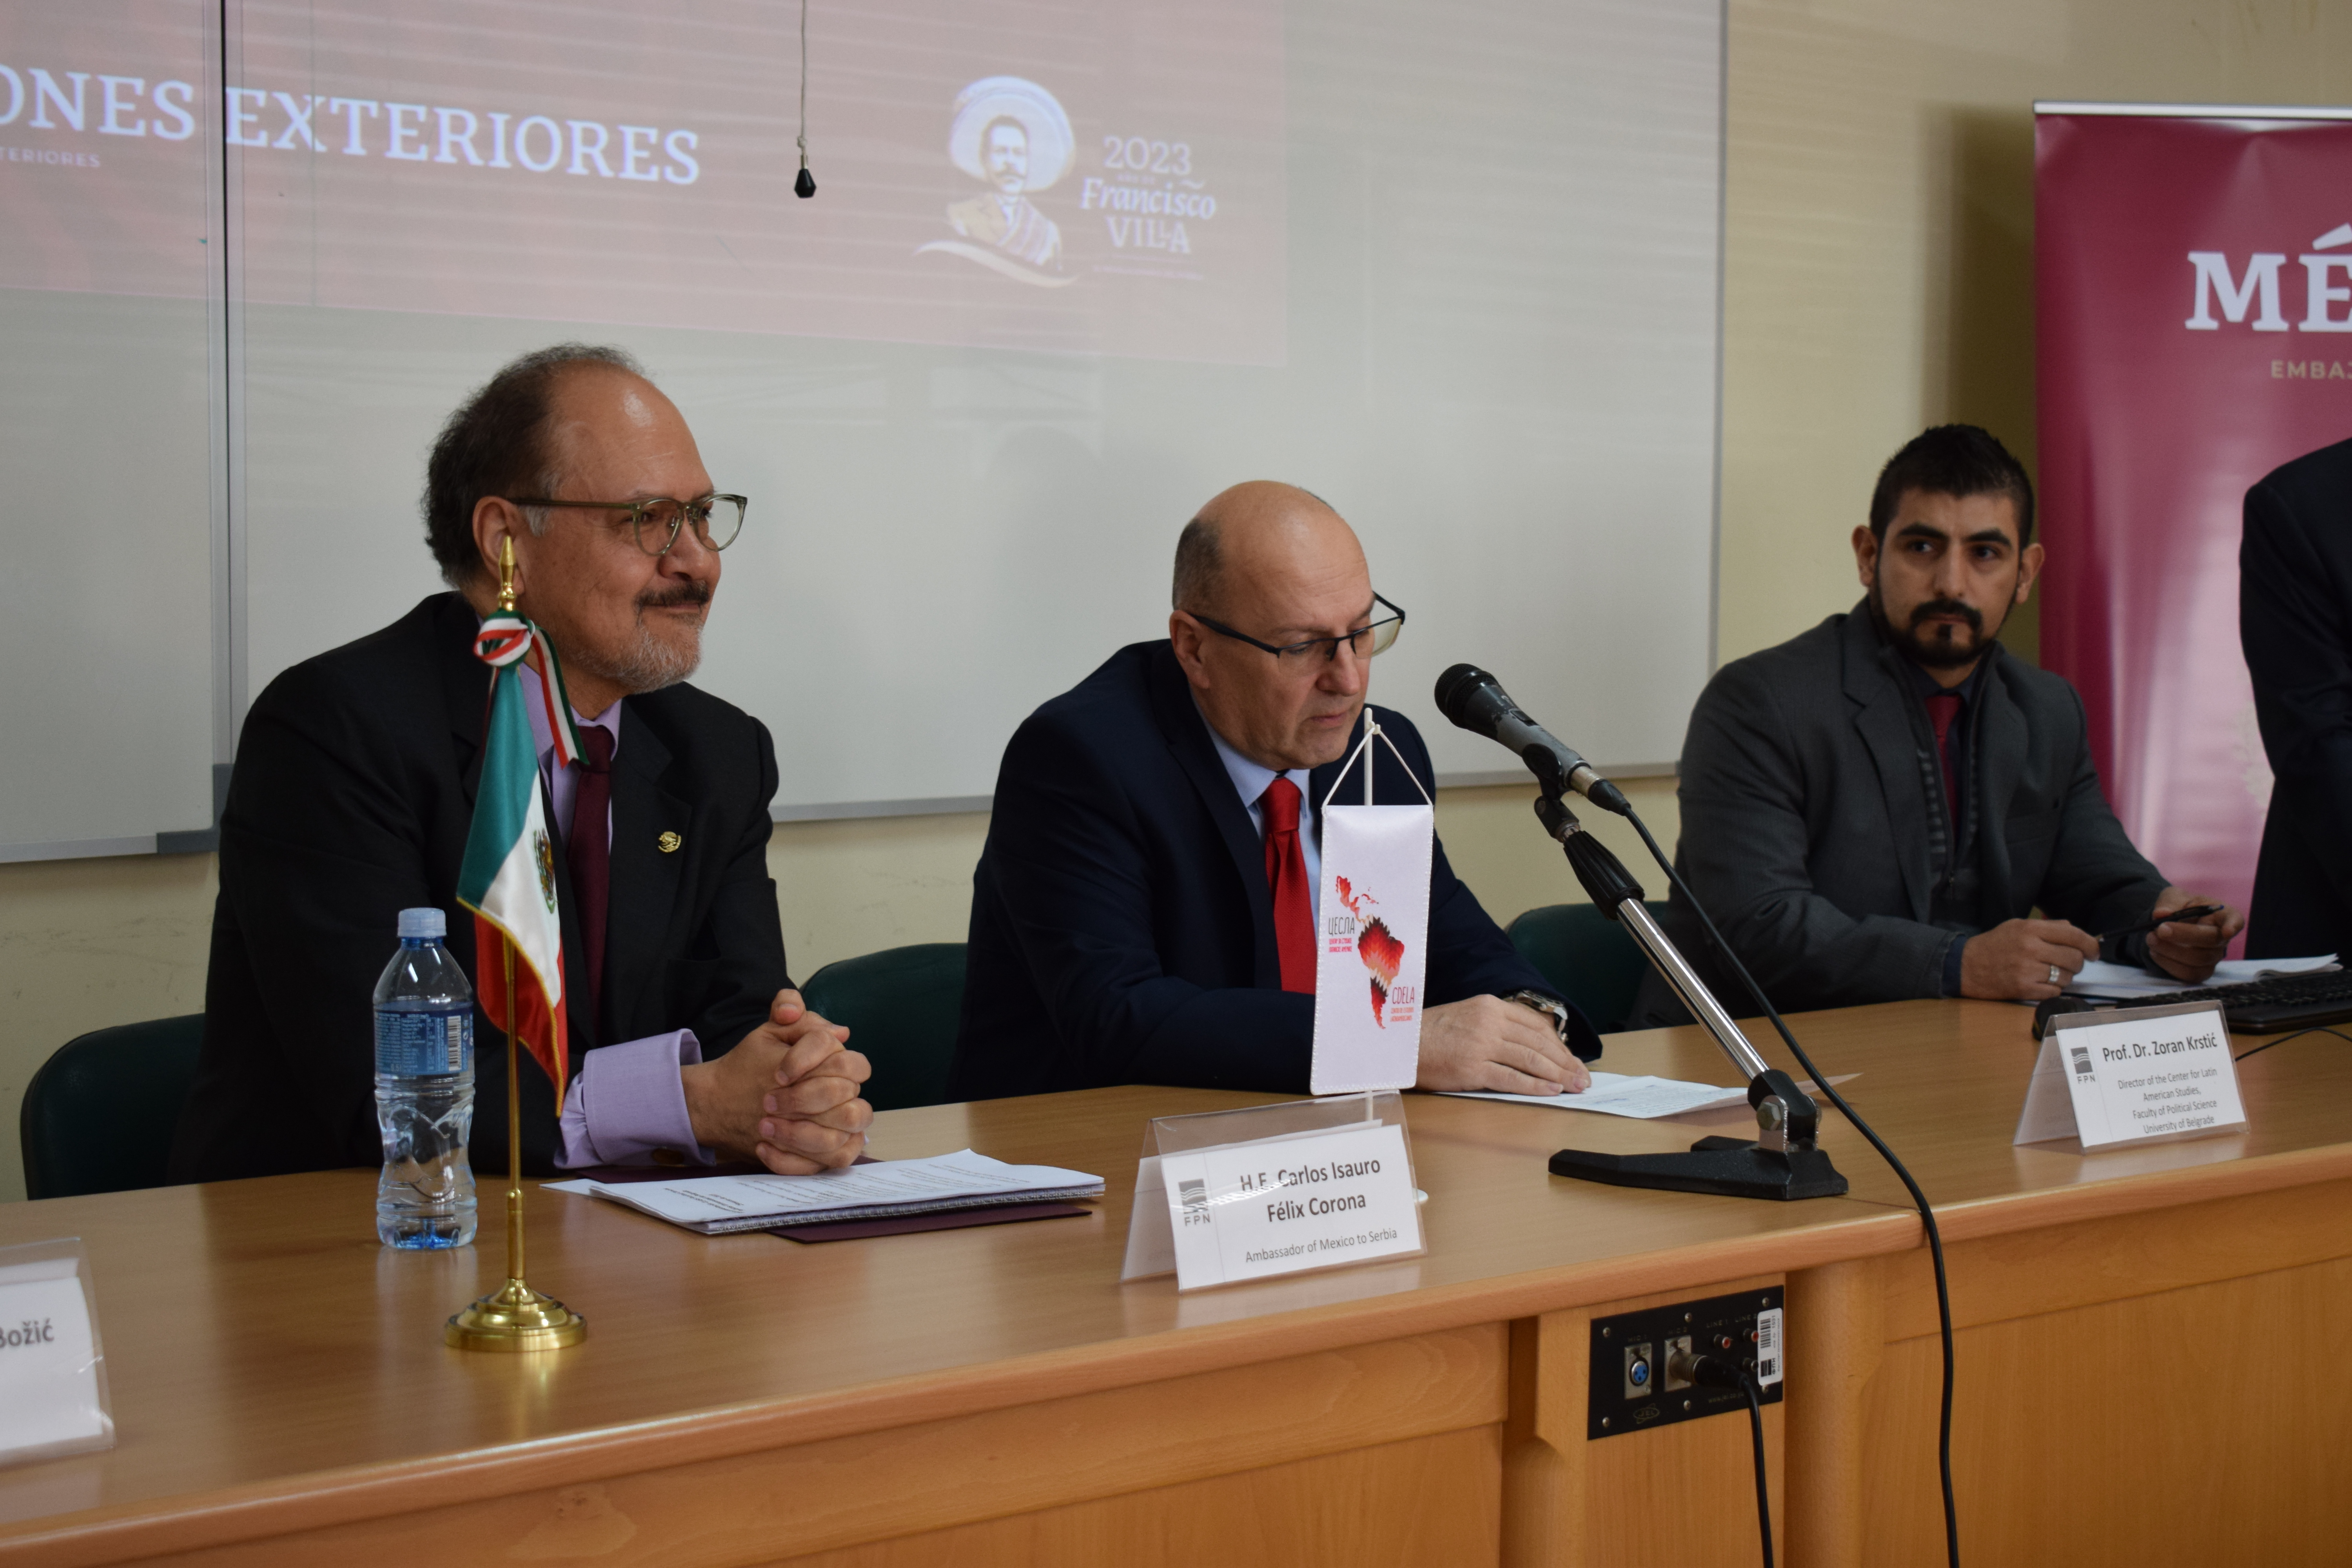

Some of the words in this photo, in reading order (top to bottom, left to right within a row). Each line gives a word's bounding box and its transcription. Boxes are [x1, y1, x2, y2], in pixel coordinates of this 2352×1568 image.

[226, 87, 700, 185] EXTERIORES
[1103, 135, 1192, 176] 2023
[1079, 176, 1218, 220] Francisco
[1105, 214, 1191, 254] VILLA
[2185, 222, 2352, 332] MÉ
[1328, 917, 1355, 936] ЦЕСЛА
[1392, 987, 1415, 1004] CDELA
[2102, 1044, 2131, 1062] Prof.
[2132, 1044, 2151, 1058] Dr.
[2151, 1040, 2185, 1055] Zoran
[2186, 1033, 2217, 1051] Krstić
[2077, 1074, 2096, 1084] FPN
[2118, 1078, 2145, 1089] Director
[2147, 1075, 2154, 1085] of
[2154, 1074, 2167, 1083] the
[2167, 1073, 2189, 1082] Center
[2190, 1070, 2200, 1078] for
[2201, 1067, 2217, 1077] Latin
[2143, 1090, 2175, 1101] American
[2175, 1086, 2201, 1097] Studies,
[2132, 1108, 2157, 1119] Faculty
[2158, 1106, 2165, 1116] of
[2166, 1102, 2192, 1114] Political
[2192, 1100, 2217, 1110] Science
[2143, 1121, 2177, 1134] University
[2178, 1118, 2185, 1129] of
[2186, 1115, 2215, 1127] Belgrade
[1278, 1165, 1328, 1187] Carlos
[1332, 1159, 1380, 1179] Isauro
[1185, 1214, 1211, 1227] FPN
[1267, 1200, 1305, 1223] Félix
[1309, 1194, 1366, 1216] Corona
[1246, 1244, 1305, 1263] Ambassador
[1307, 1240, 1318, 1252] of
[1320, 1237, 1355, 1250] Mexico
[1357, 1234, 1367, 1244] to
[1369, 1228, 1397, 1243] Serbia
